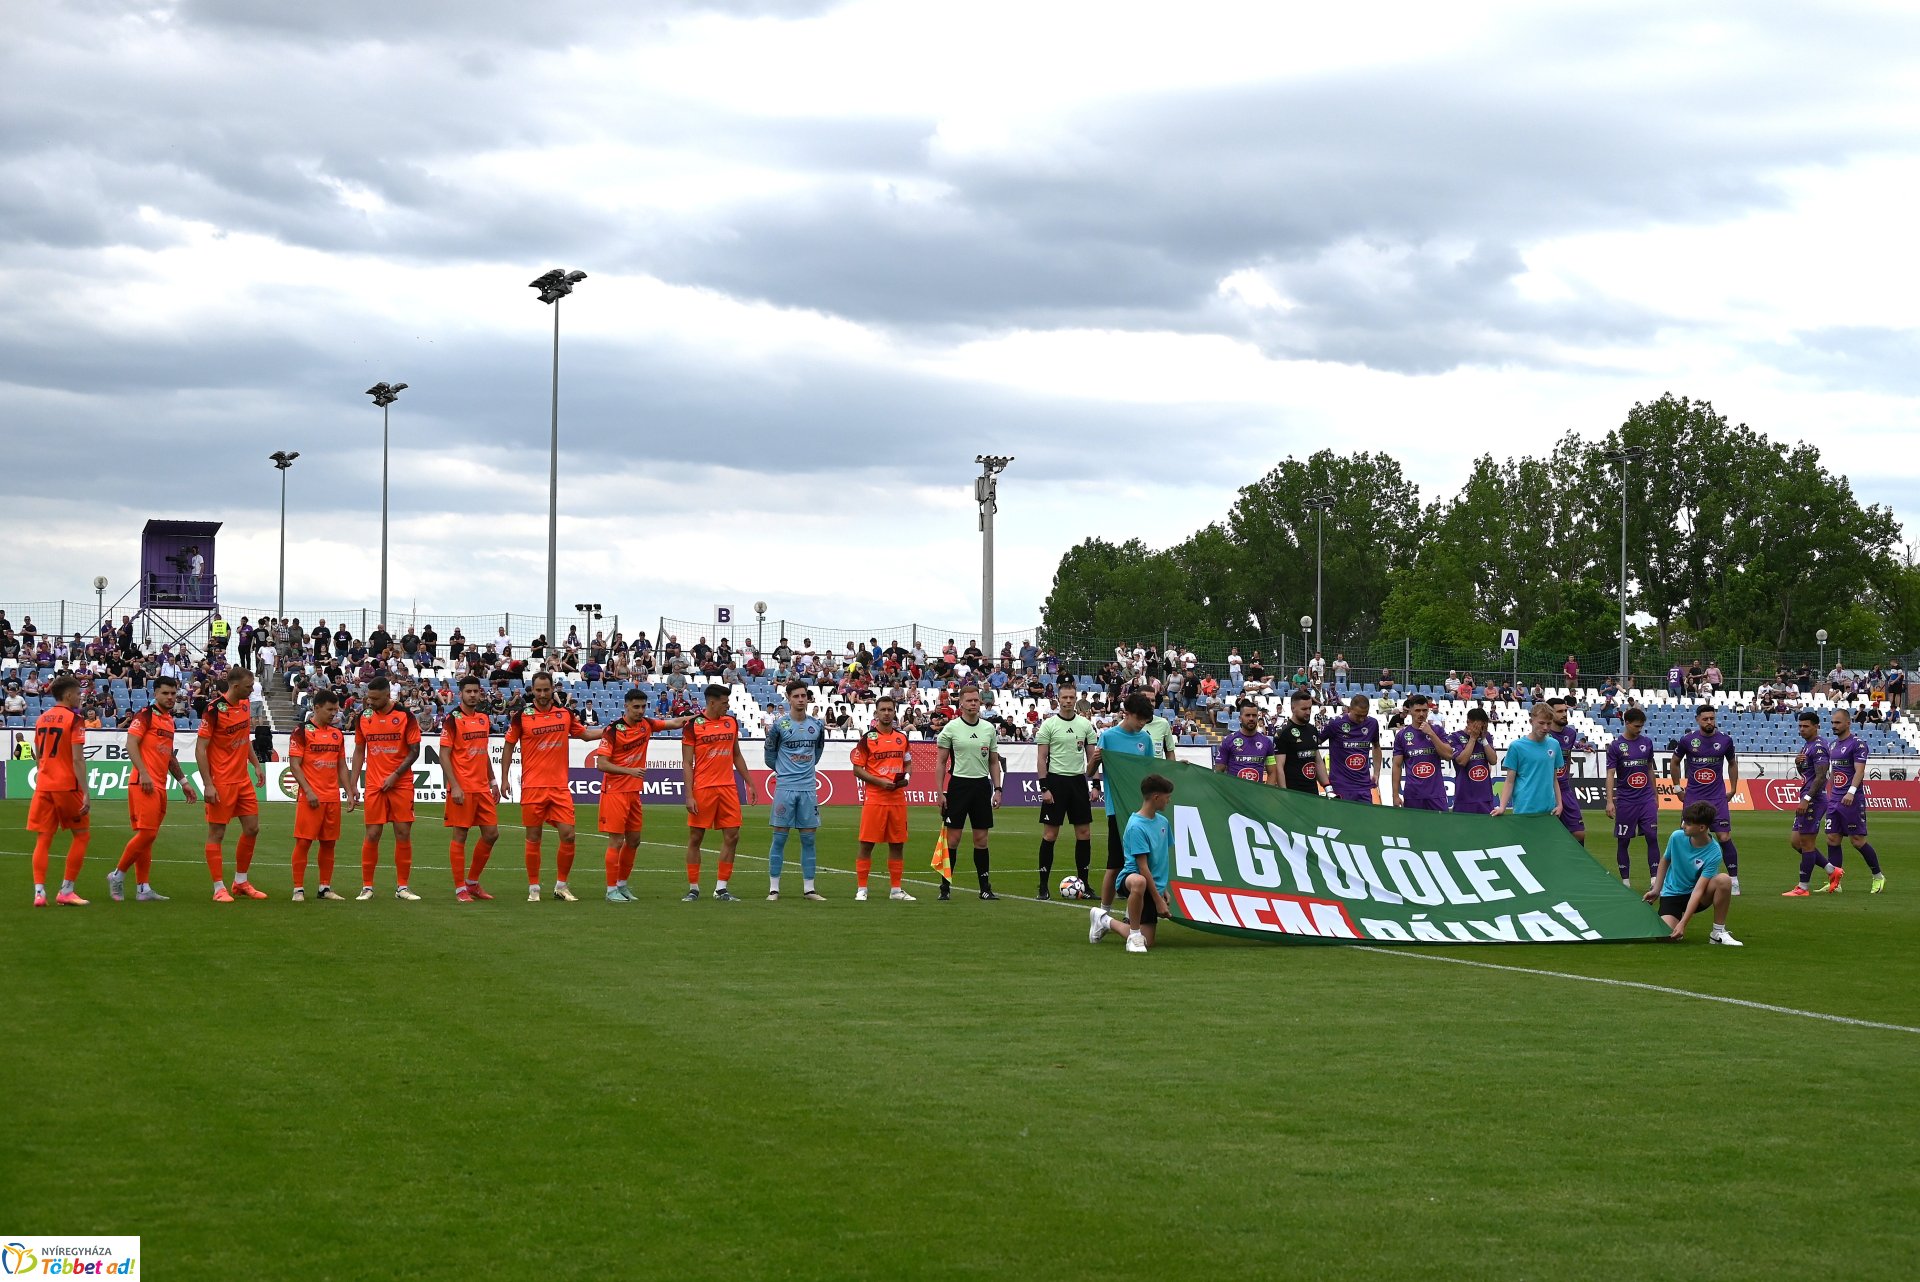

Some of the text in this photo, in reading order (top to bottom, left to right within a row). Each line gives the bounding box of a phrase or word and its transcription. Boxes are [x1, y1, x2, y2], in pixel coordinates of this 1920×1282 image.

[718, 607, 731, 622] B
[1503, 632, 1516, 646] A
[38, 727, 63, 759] 77
[1619, 824, 1628, 835] 17
[1173, 805, 1546, 906] A GYŰLÖLET
